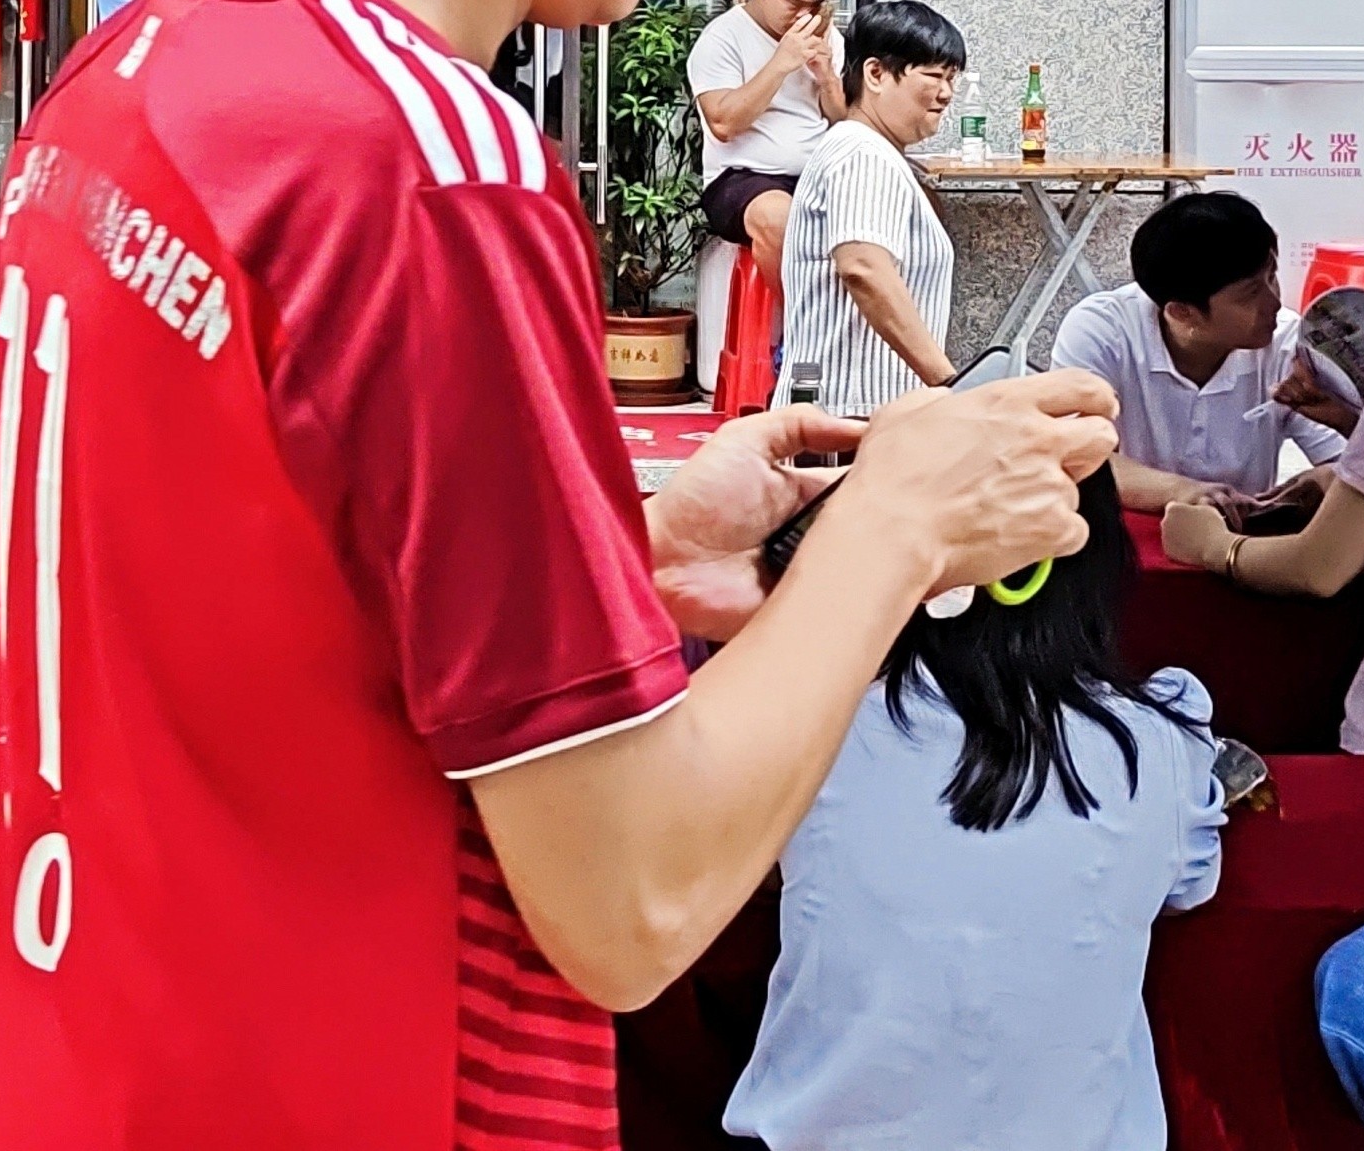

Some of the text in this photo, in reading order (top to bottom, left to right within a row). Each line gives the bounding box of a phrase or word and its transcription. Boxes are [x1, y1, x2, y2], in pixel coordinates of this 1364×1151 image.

[1244, 132, 1359, 163] 灭火器
[1237, 167, 1363, 178] FIRE EXTINGUISHER
